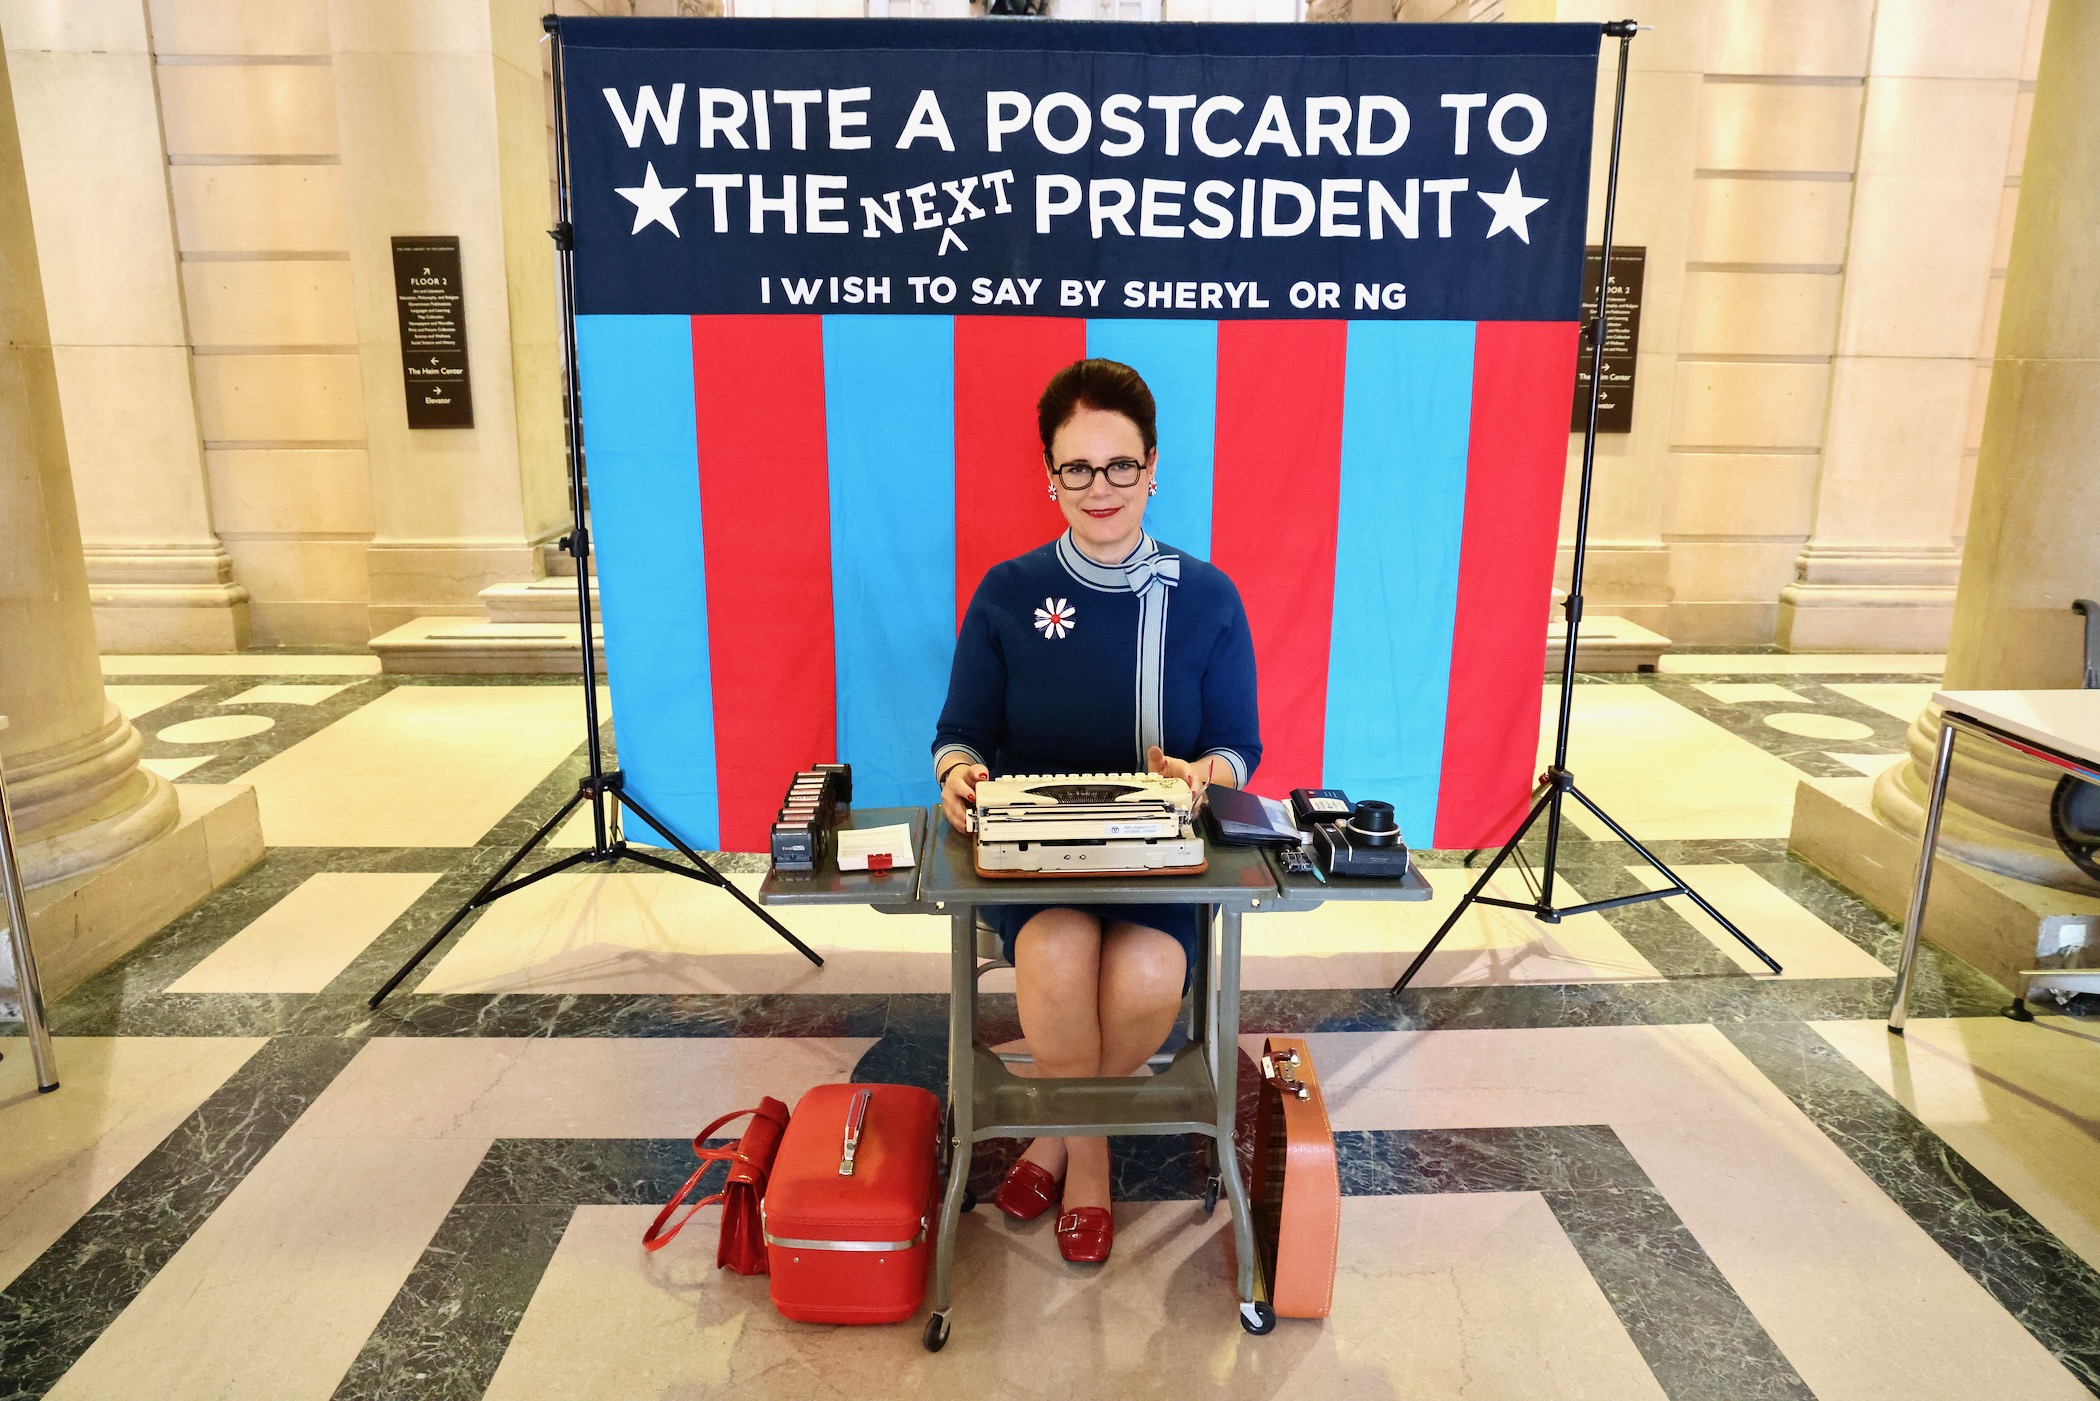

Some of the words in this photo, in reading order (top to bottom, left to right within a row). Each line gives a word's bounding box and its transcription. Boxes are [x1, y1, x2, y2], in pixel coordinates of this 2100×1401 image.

[603, 83, 871, 150] WRITE
[896, 90, 955, 151] A
[987, 91, 1410, 157] POSTCARD
[1441, 93, 1547, 155] TO
[696, 174, 849, 234] THE
[860, 170, 1014, 238] NEXT
[1036, 174, 1468, 239] PRESIDENT
[411, 278, 440, 286] FLOOR
[442, 278, 448, 286] 2
[761, 277, 770, 303] I
[781, 277, 890, 304] WISH
[908, 277, 956, 303] TO
[972, 278, 1042, 304] SAY
[1061, 280, 1105, 306] BY
[1124, 281, 1269, 308] SHERYL
[408, 367, 421, 375] The
[422, 367, 440, 375] Heim
[440, 367, 463, 375] Center
